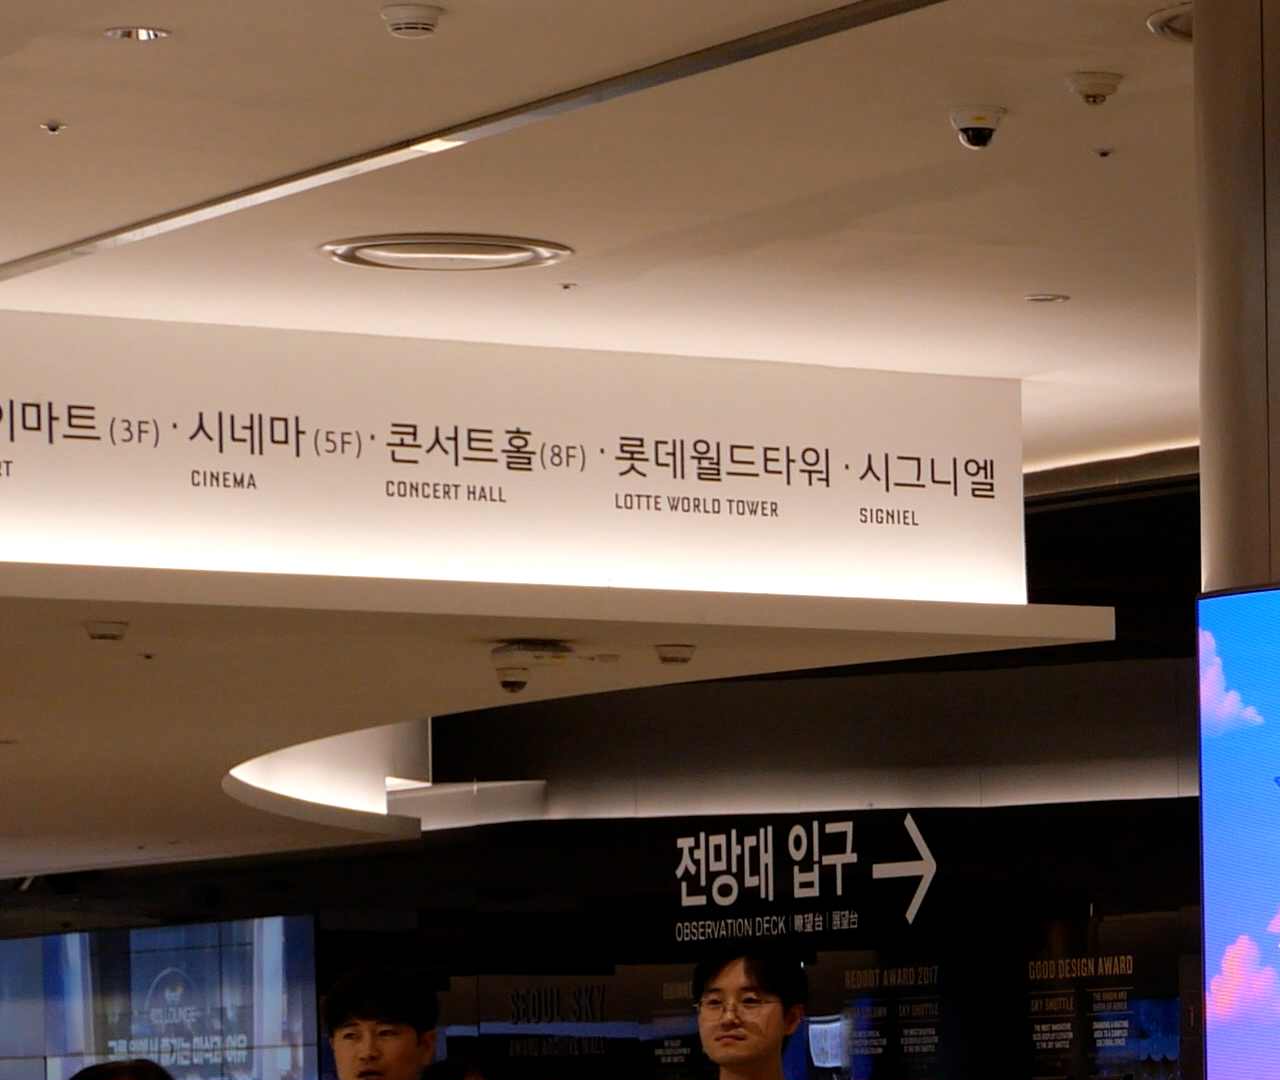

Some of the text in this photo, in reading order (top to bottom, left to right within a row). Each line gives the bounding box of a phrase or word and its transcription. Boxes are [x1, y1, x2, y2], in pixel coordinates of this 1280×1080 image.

[190, 469, 258, 490] CINEMA
[614, 436, 831, 488] 롯데월드타워
[859, 452, 996, 499] 시그니엘
[385, 480, 507, 503] CONCERT HALL
[614, 492, 779, 517] LOTTE WORLD TOWER
[859, 507, 920, 527] SIGNIEL
[675, 820, 858, 907] 전망대 입구
[675, 919, 753, 942] OBSERVATION
[755, 915, 787, 937] DECK
[1028, 955, 1134, 981] GOOD DESIGN AWARD
